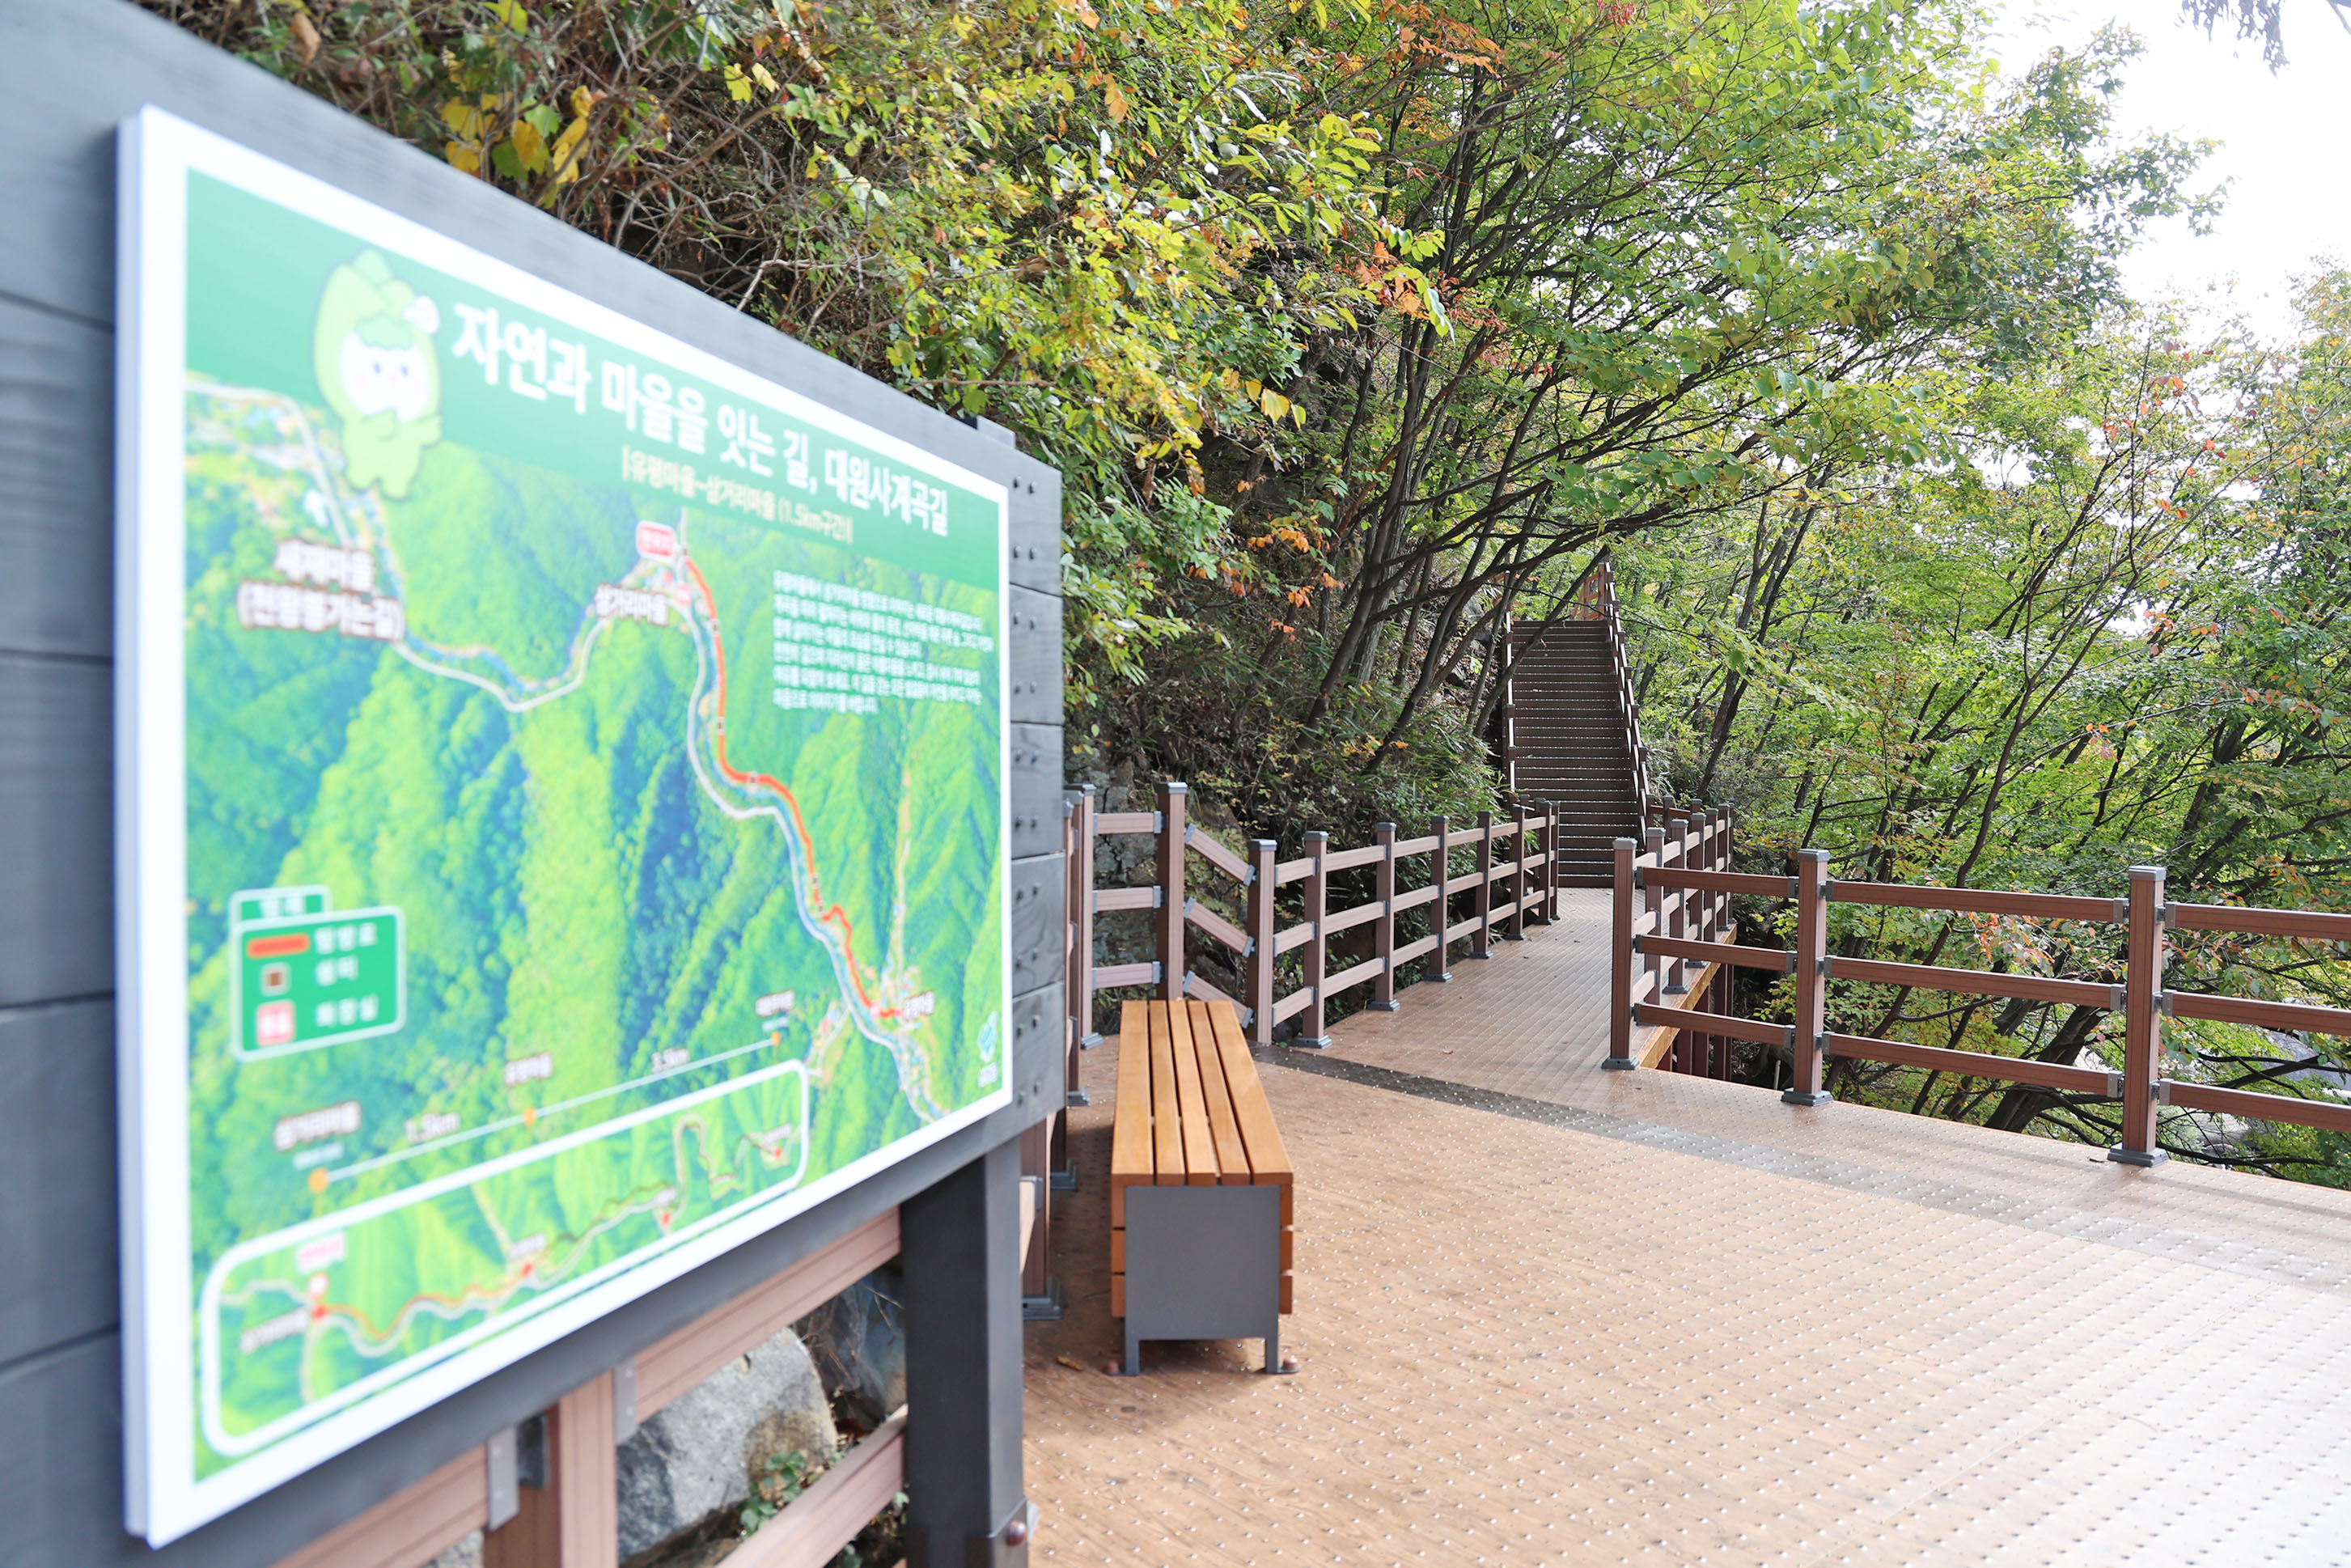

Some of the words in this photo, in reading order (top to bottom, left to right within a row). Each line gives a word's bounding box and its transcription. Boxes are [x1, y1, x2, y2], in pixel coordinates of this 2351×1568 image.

[454, 302, 591, 414] 자연과
[601, 362, 708, 454] 마을을
[718, 401, 776, 477] 잇는
[783, 429, 816, 497] 길,
[824, 447, 947, 537] 대원사계곡길
